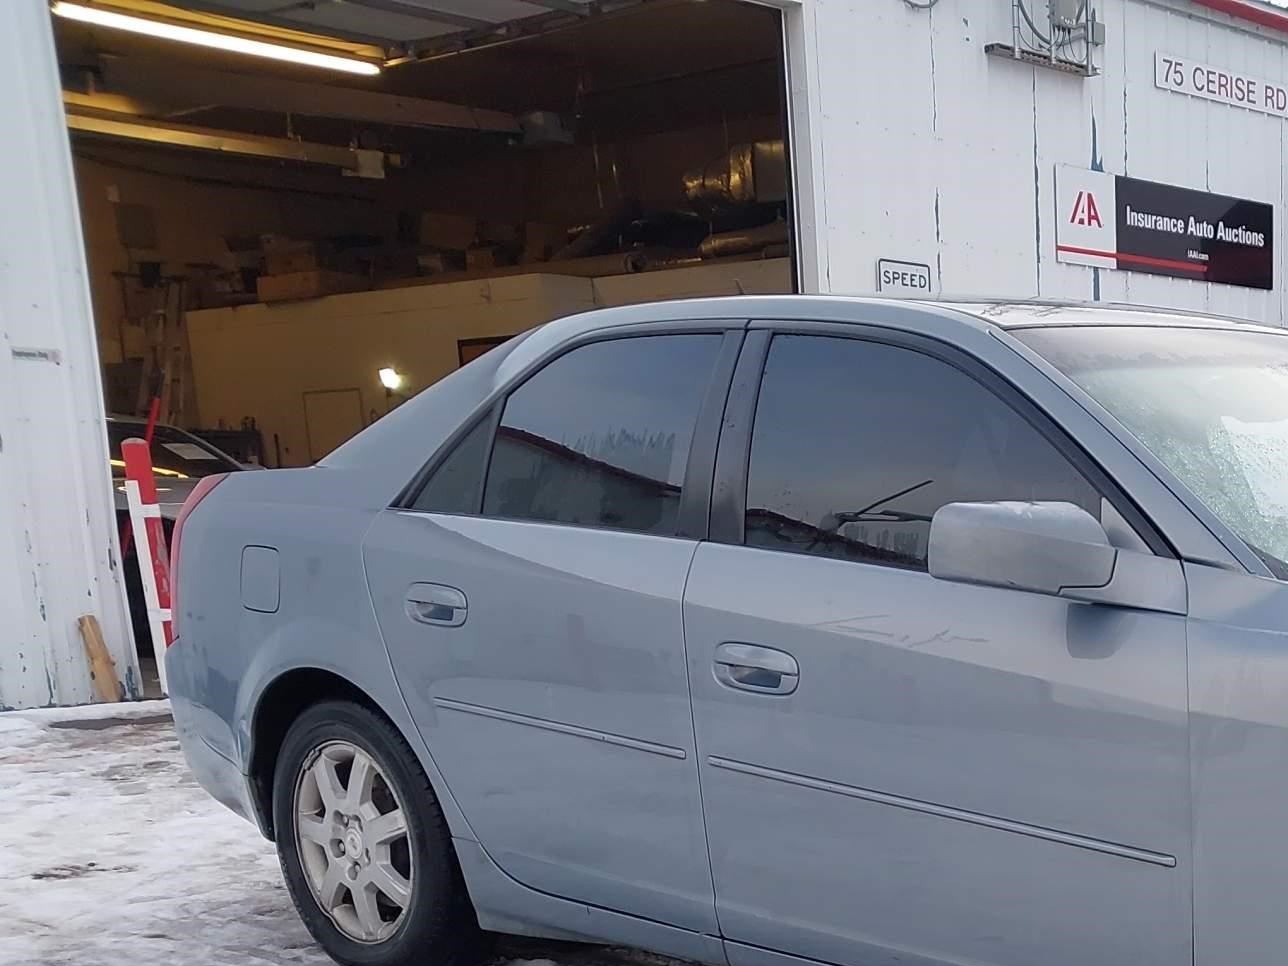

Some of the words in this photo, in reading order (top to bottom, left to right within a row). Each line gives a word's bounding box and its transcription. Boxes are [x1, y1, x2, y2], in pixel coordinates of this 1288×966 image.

[1162, 57, 1184, 87] 75
[1192, 66, 1257, 105] CERISE
[1126, 204, 1185, 234] Insurance
[1187, 215, 1214, 240] Auto
[1216, 220, 1265, 248] Auctions
[883, 269, 927, 289] SPEED
